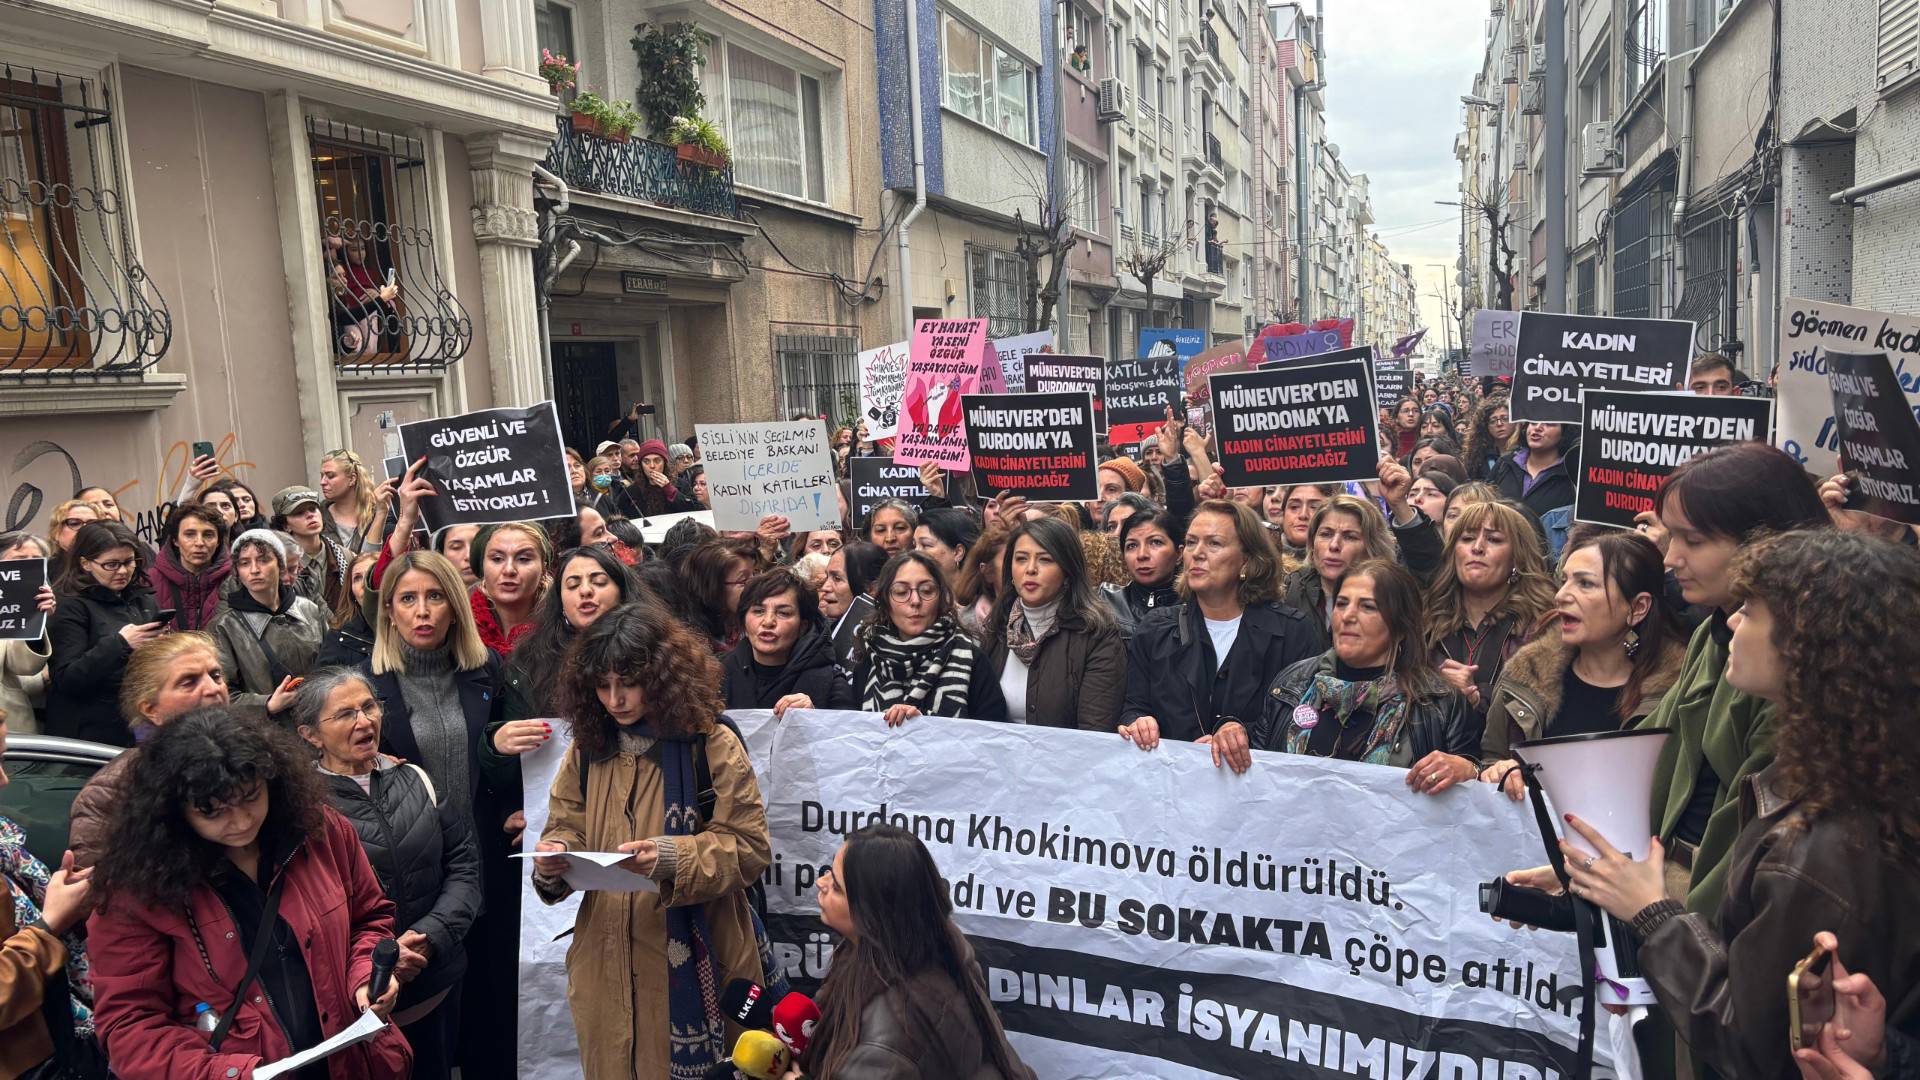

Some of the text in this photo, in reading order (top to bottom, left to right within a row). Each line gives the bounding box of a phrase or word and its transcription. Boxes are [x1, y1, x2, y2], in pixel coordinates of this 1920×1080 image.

[921, 322, 980, 334] EY HAYAT!
[1788, 310, 1920, 355] göçmen kad
[931, 334, 970, 347] YA SENİ
[1267, 339, 1316, 357] KADIN
[1561, 331, 1636, 352] KADIN
[929, 346, 965, 360] ÖZGÜR
[911, 360, 978, 375] YAŞAYACAĞIM
[1029, 361, 1102, 380] MÜNEVVER'DEN
[1105, 361, 1148, 380] KATİL
[1523, 353, 1673, 386] CİNAYETLERİ
[1037, 380, 1097, 396] DURDONA'YA
[1219, 378, 1359, 410] MÜNEVVER'DEN
[1527, 383, 1583, 404] POLİ
[1861, 376, 1879, 397] VE
[1106, 392, 1170, 410] RKEKLER
[969, 405, 1083, 428] MÜNEVVER'DEN
[1232, 404, 1350, 433] DURDONA'YA
[1591, 405, 1755, 441] MÜNEVVER'DEN
[430, 419, 527, 447] GÜVENLİ VE
[979, 431, 1073, 450] DURDONA'YA
[1224, 426, 1366, 455] KADIN CİNAYETLERİNİ
[455, 445, 512, 468] ÖZGÜR
[705, 448, 755, 461] BELEDİYE
[901, 447, 965, 462] SAYACAĞIM!
[975, 452, 1087, 471] KADIN CİNAYETLERİNİ
[1245, 449, 1348, 472] DURDURACAĞIZ
[1844, 440, 1909, 470] YAŞAMLAR
[439, 468, 538, 494] YAŞAMLAR
[713, 470, 832, 497] KADIN KATİLLERİ
[879, 467, 920, 479] KADIN
[987, 470, 1071, 488] DURDURACAĞIZ
[1588, 466, 1668, 491] KADIN CİNAY
[858, 483, 930, 497] CİNAYETLE
[452, 492, 538, 512] İSTİYORUZ
[1605, 491, 1656, 513] DURDUR
[0, 570, 21, 581] VE
[801, 800, 1404, 911] Durdona Khokimova öldürüldü.
[995, 886, 1035, 918] ve
[1047, 886, 1107, 929] BU
[1117, 898, 1333, 960] SOKAKTA
[1345, 933, 1447, 986] çöpe
